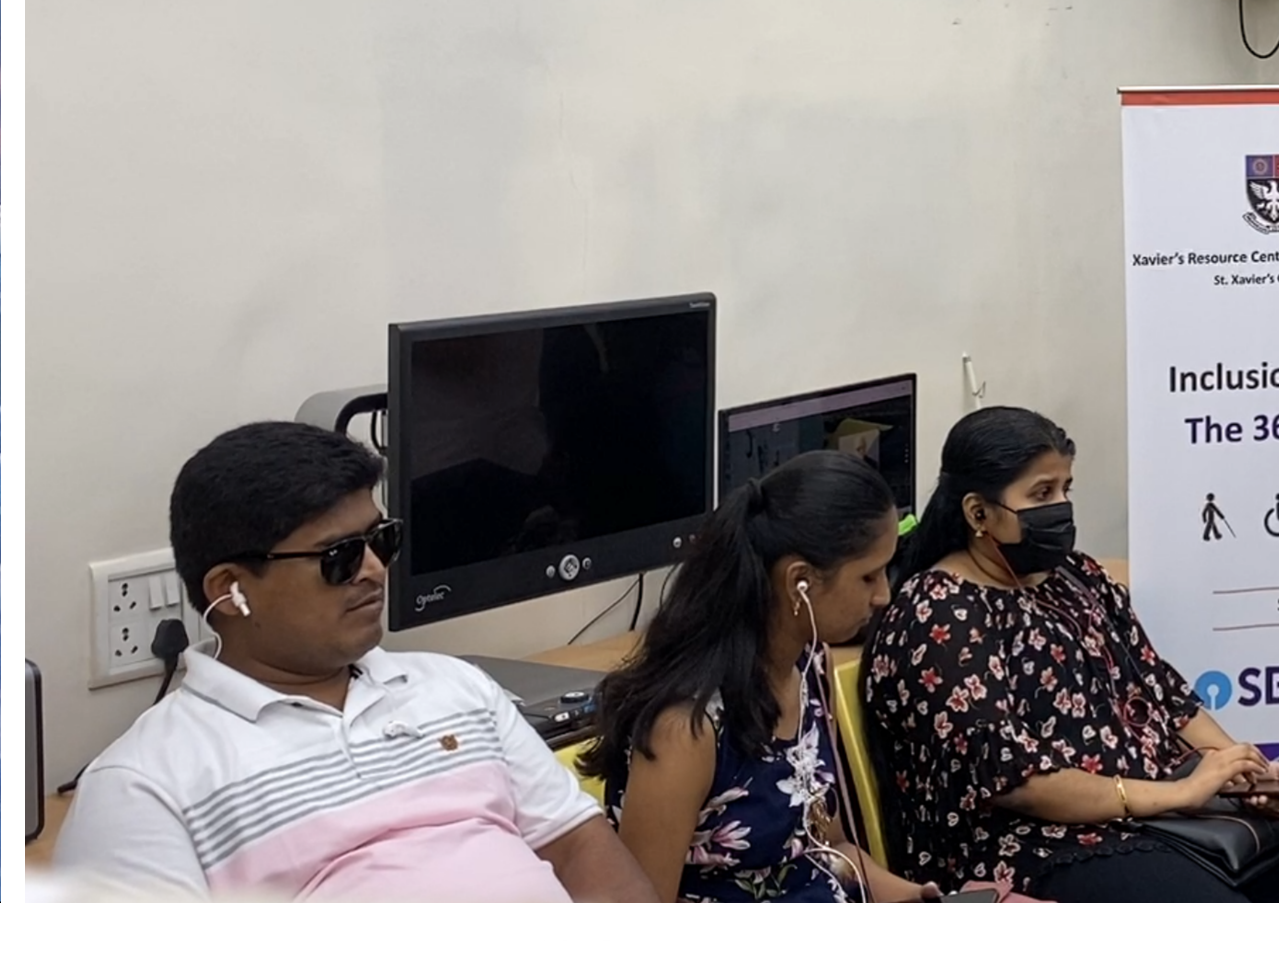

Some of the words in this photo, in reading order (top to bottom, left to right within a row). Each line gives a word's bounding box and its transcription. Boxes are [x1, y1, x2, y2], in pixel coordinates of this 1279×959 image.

[1132, 252, 1185, 267] Xavier's
[1188, 252, 1247, 265] Resource
[1214, 275, 1229, 286] St.
[1231, 273, 1275, 286] Xavier's
[1184, 415, 1244, 444] The
